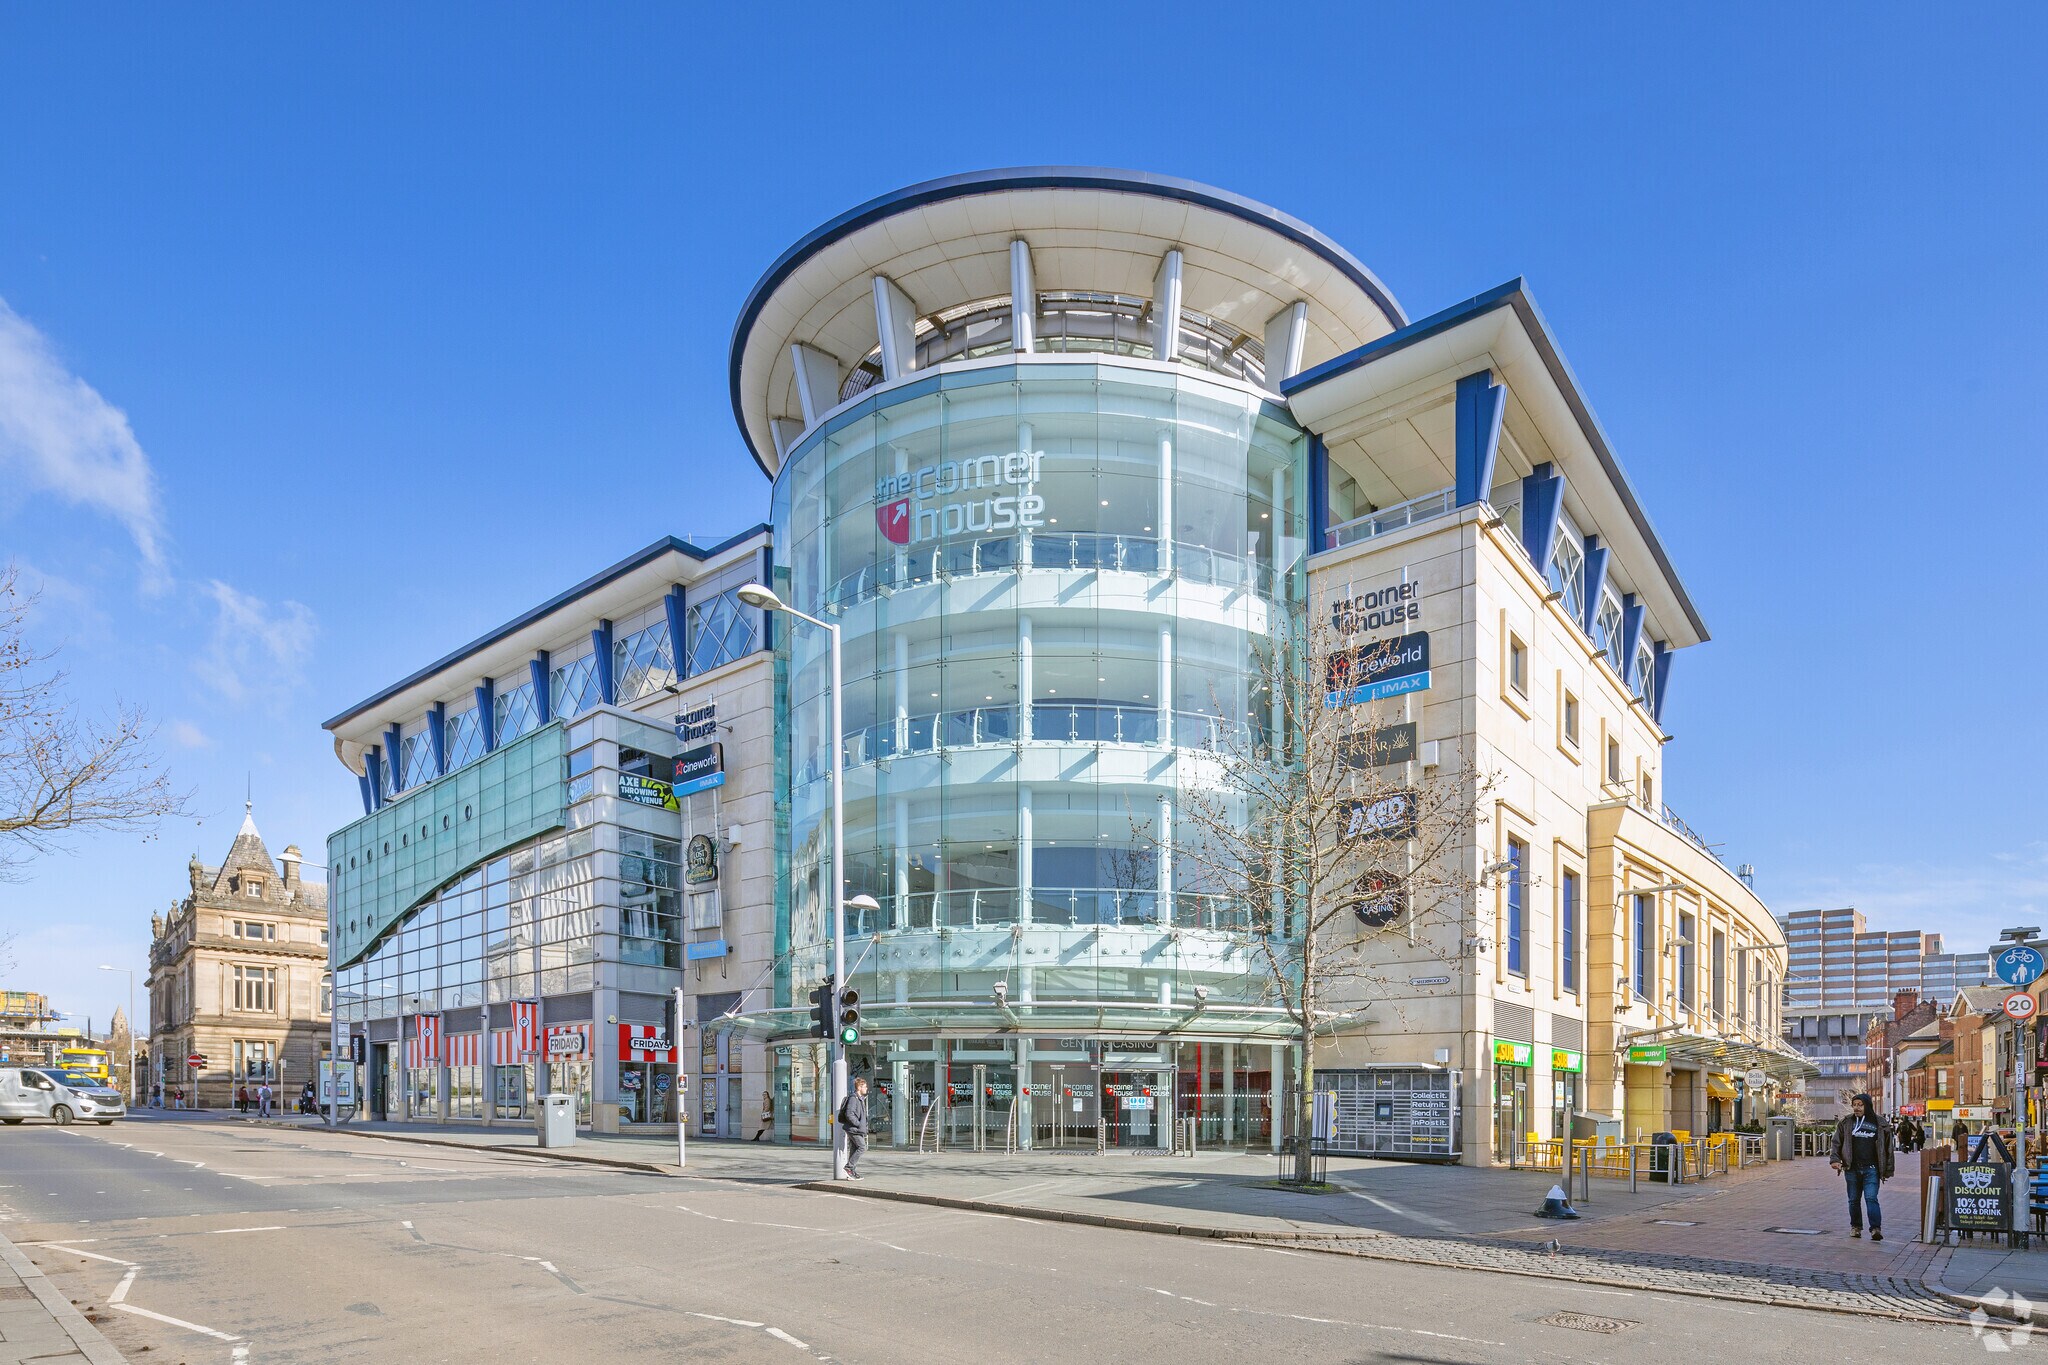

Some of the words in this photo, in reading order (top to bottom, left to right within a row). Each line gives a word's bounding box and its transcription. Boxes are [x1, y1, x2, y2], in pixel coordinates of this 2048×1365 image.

[876, 472, 912, 501] the
[915, 450, 1045, 499] corner
[914, 495, 1045, 542] house
[1355, 581, 1419, 612] corner
[1382, 678, 1421, 694] IMAX
[686, 704, 716, 724] corner
[685, 721, 717, 741] house
[683, 753, 718, 774] cineworld
[619, 776, 639, 787] AXE
[699, 776, 718, 787] IMAX
[621, 786, 658, 796] THROWING
[641, 795, 663, 805] VENUE
[1362, 903, 1393, 914] CASINO
[2008, 1000, 2032, 1011] 20
[550, 1036, 579, 1050] FRIDAYS
[633, 1039, 670, 1049] FRIDAYS
[1113, 1040, 1155, 1049] CASINO
[1498, 1044, 1531, 1063] SUBWAY
[1555, 1053, 1581, 1069] SUBWAY
[1958, 1166, 1996, 1176] THEATRE
[1954, 1186, 2001, 1196] DISCOUNT
[1956, 1197, 1976, 1208] 10%
[1977, 1198, 1999, 1209] OFF
[1978, 1208, 2002, 1216] DRINK
